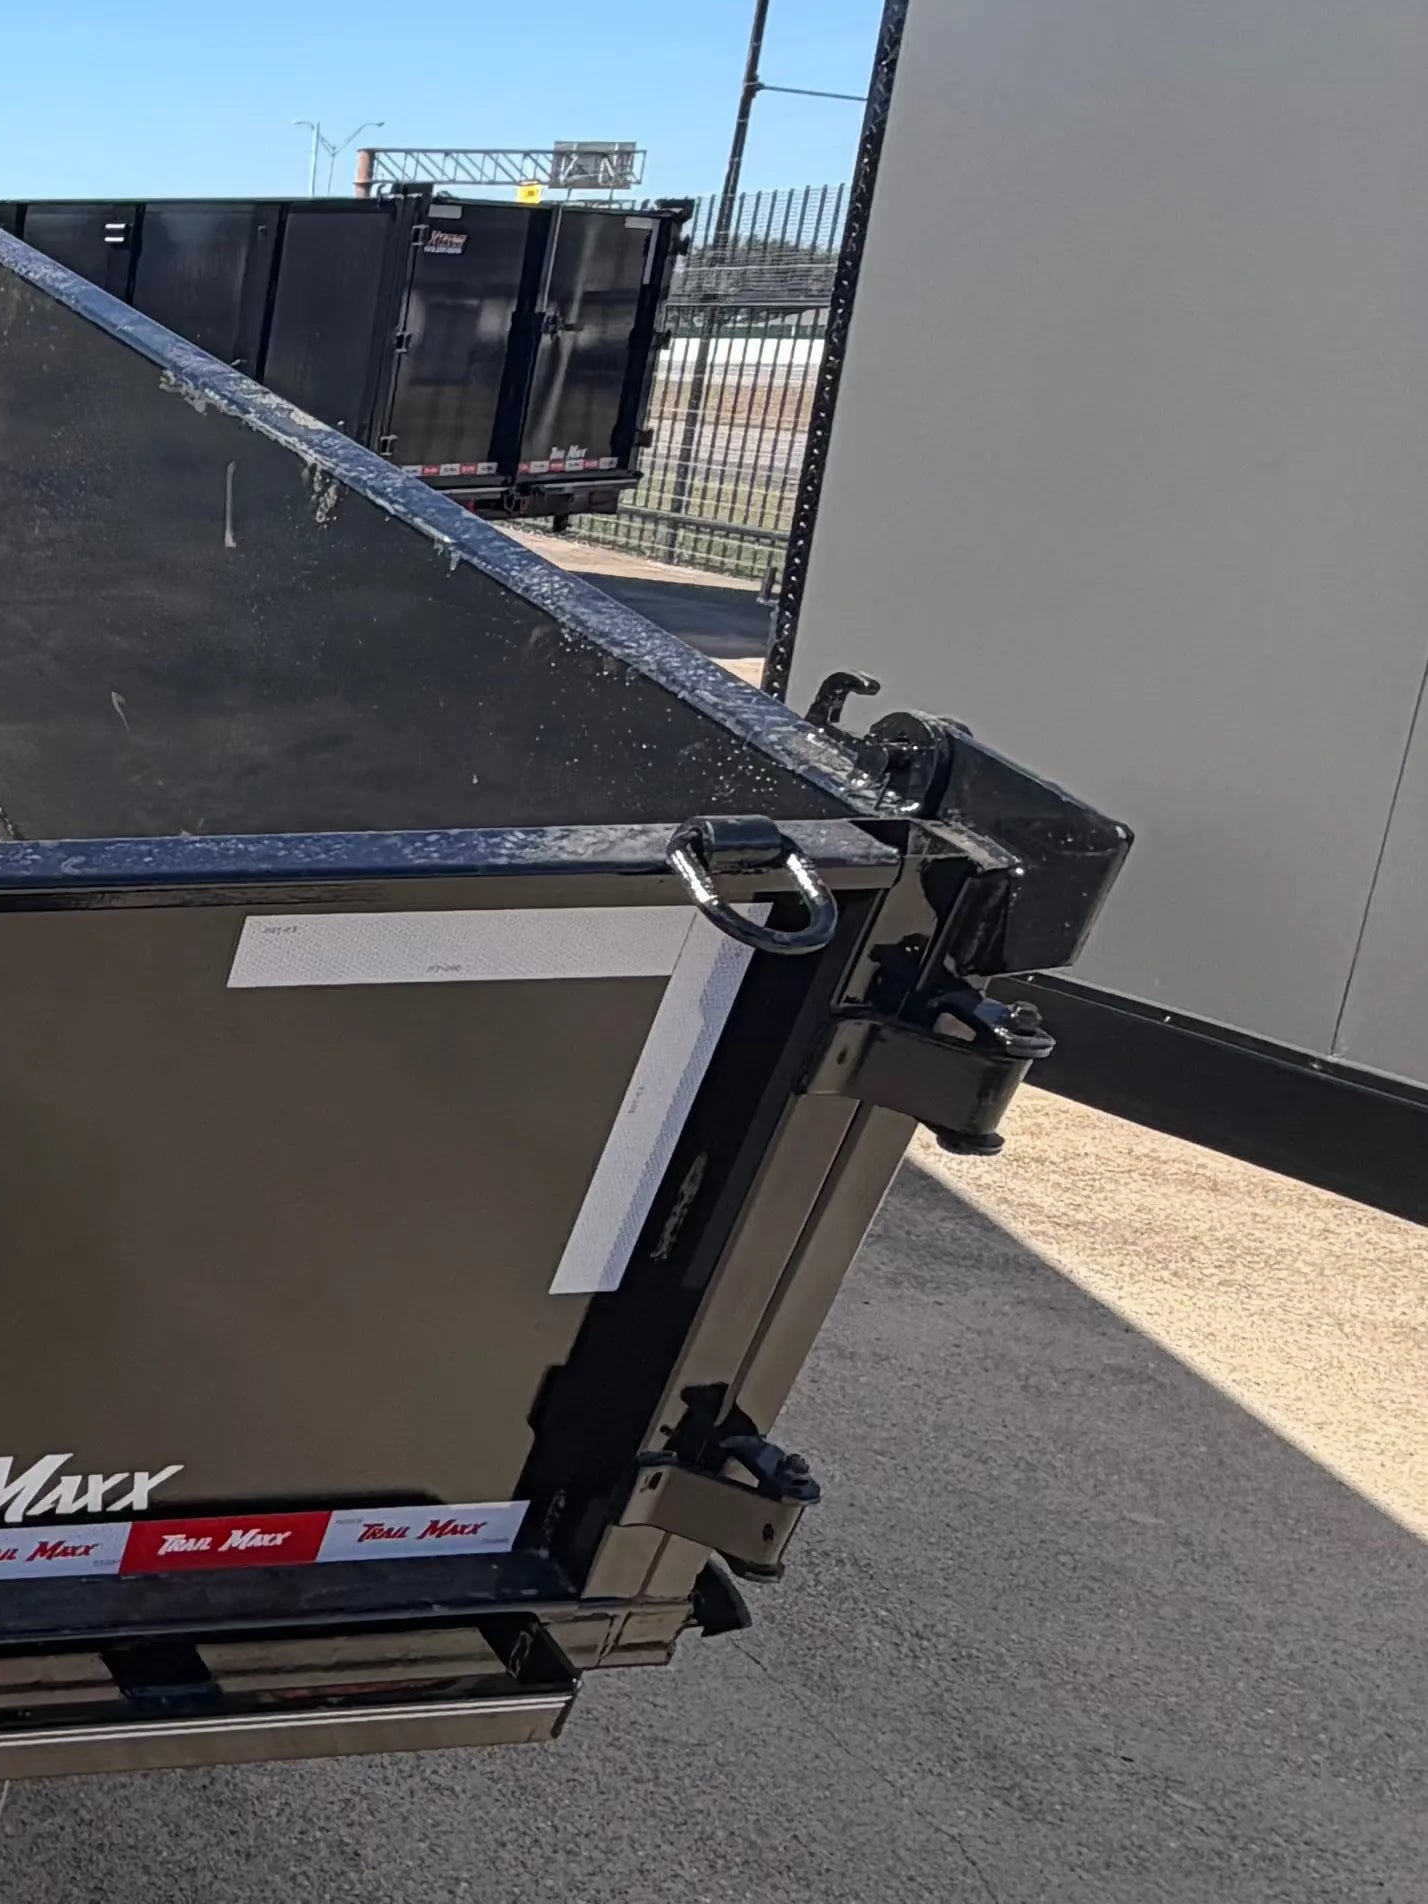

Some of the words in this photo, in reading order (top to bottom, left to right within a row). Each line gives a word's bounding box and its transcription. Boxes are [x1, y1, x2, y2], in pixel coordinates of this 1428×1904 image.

[157, 1534, 211, 1555] TRAIL
[218, 1528, 292, 1551] MAXX
[356, 1522, 408, 1542] TRAIL
[417, 1518, 488, 1539] MAXX
[27, 1540, 99, 1561] MAXX
